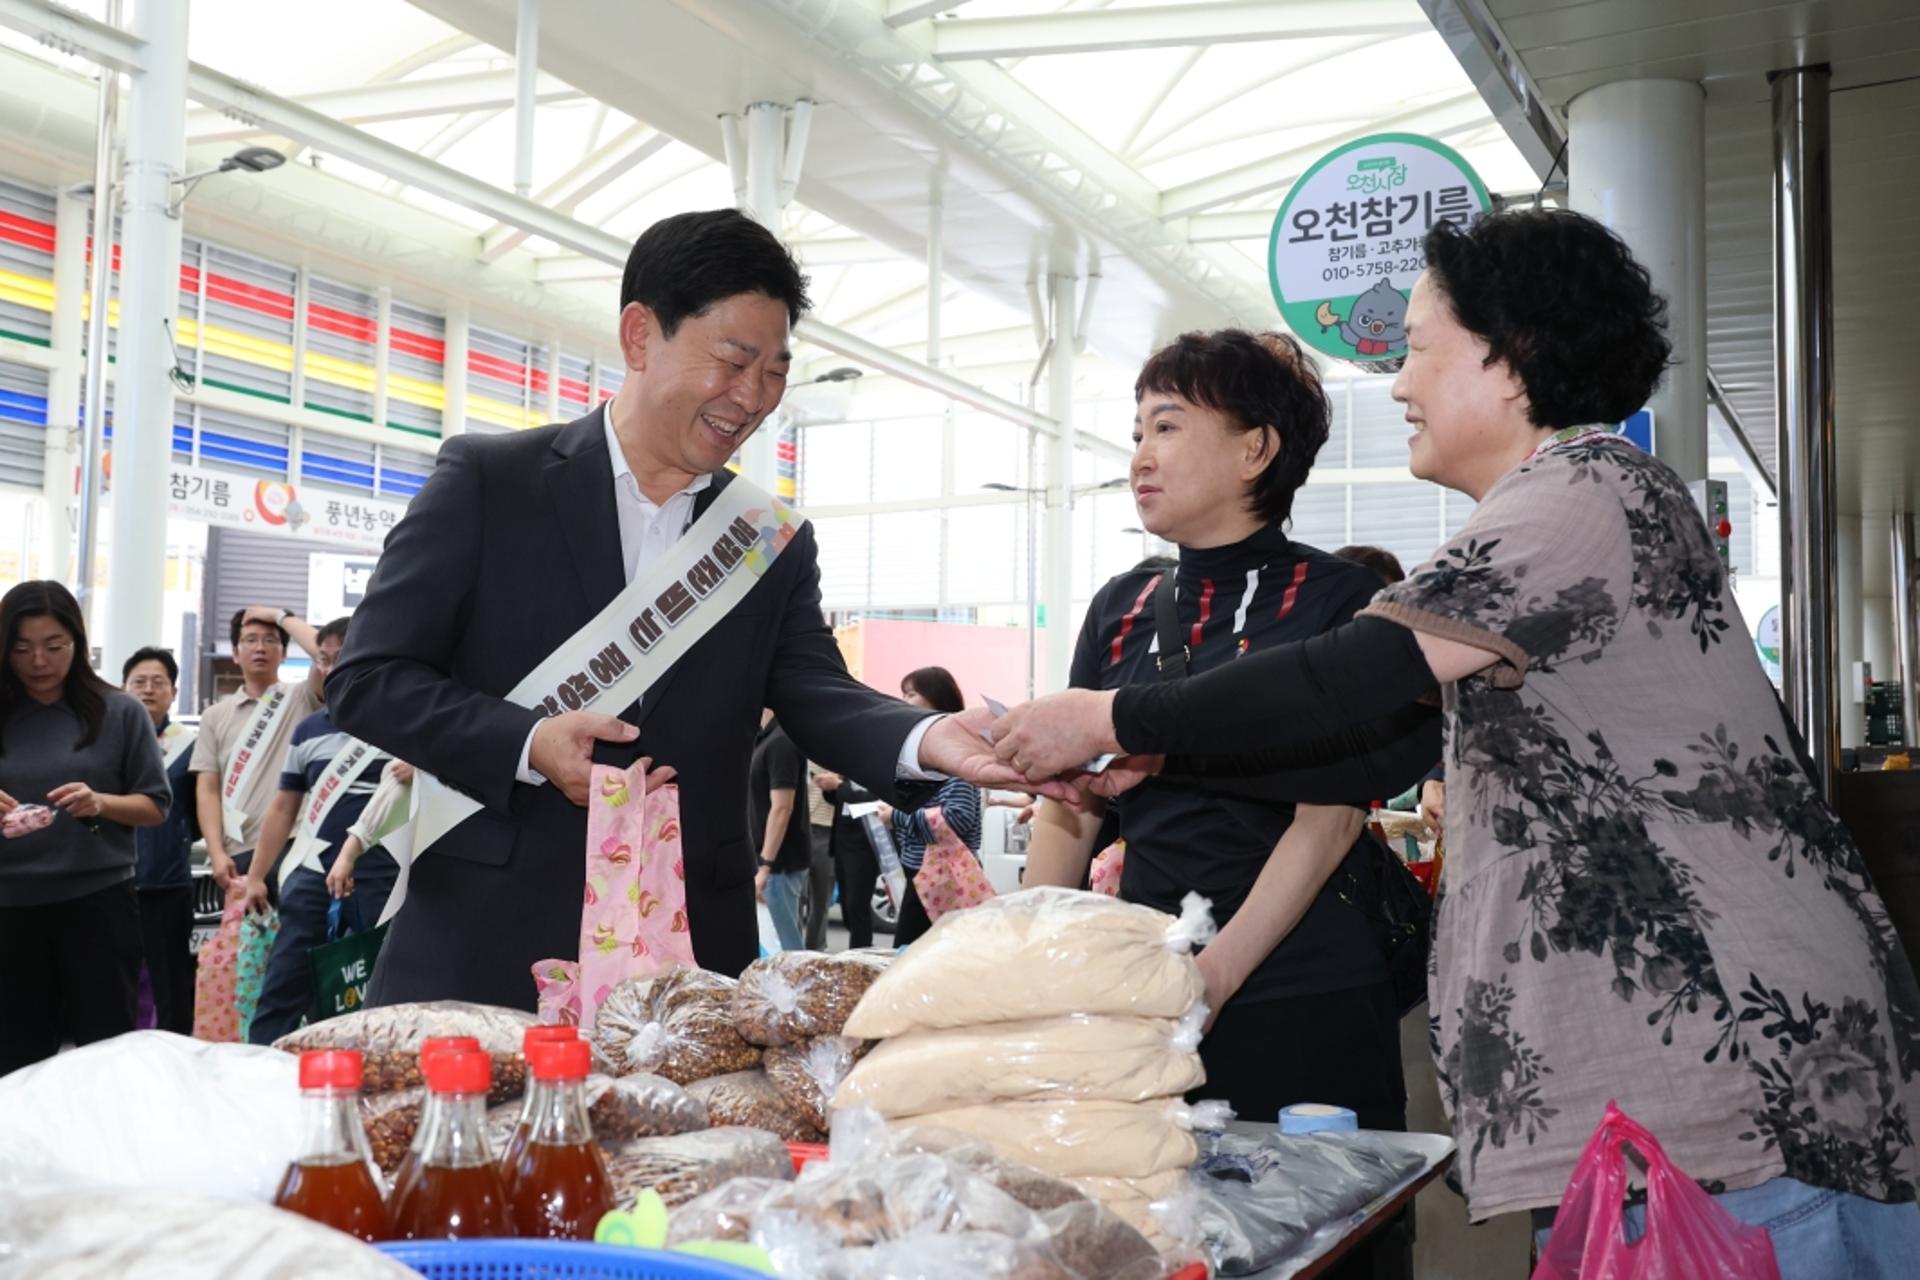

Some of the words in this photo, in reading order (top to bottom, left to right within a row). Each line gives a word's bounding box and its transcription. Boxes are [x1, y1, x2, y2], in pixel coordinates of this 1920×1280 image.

[1346, 163, 1408, 194] 오천시장
[1288, 185, 1473, 244] 오천참기름
[1327, 243, 1367, 262] 참기름
[169, 472, 232, 507] 참기름
[325, 500, 397, 531] 풍년농약
[341, 959, 367, 984] WE
